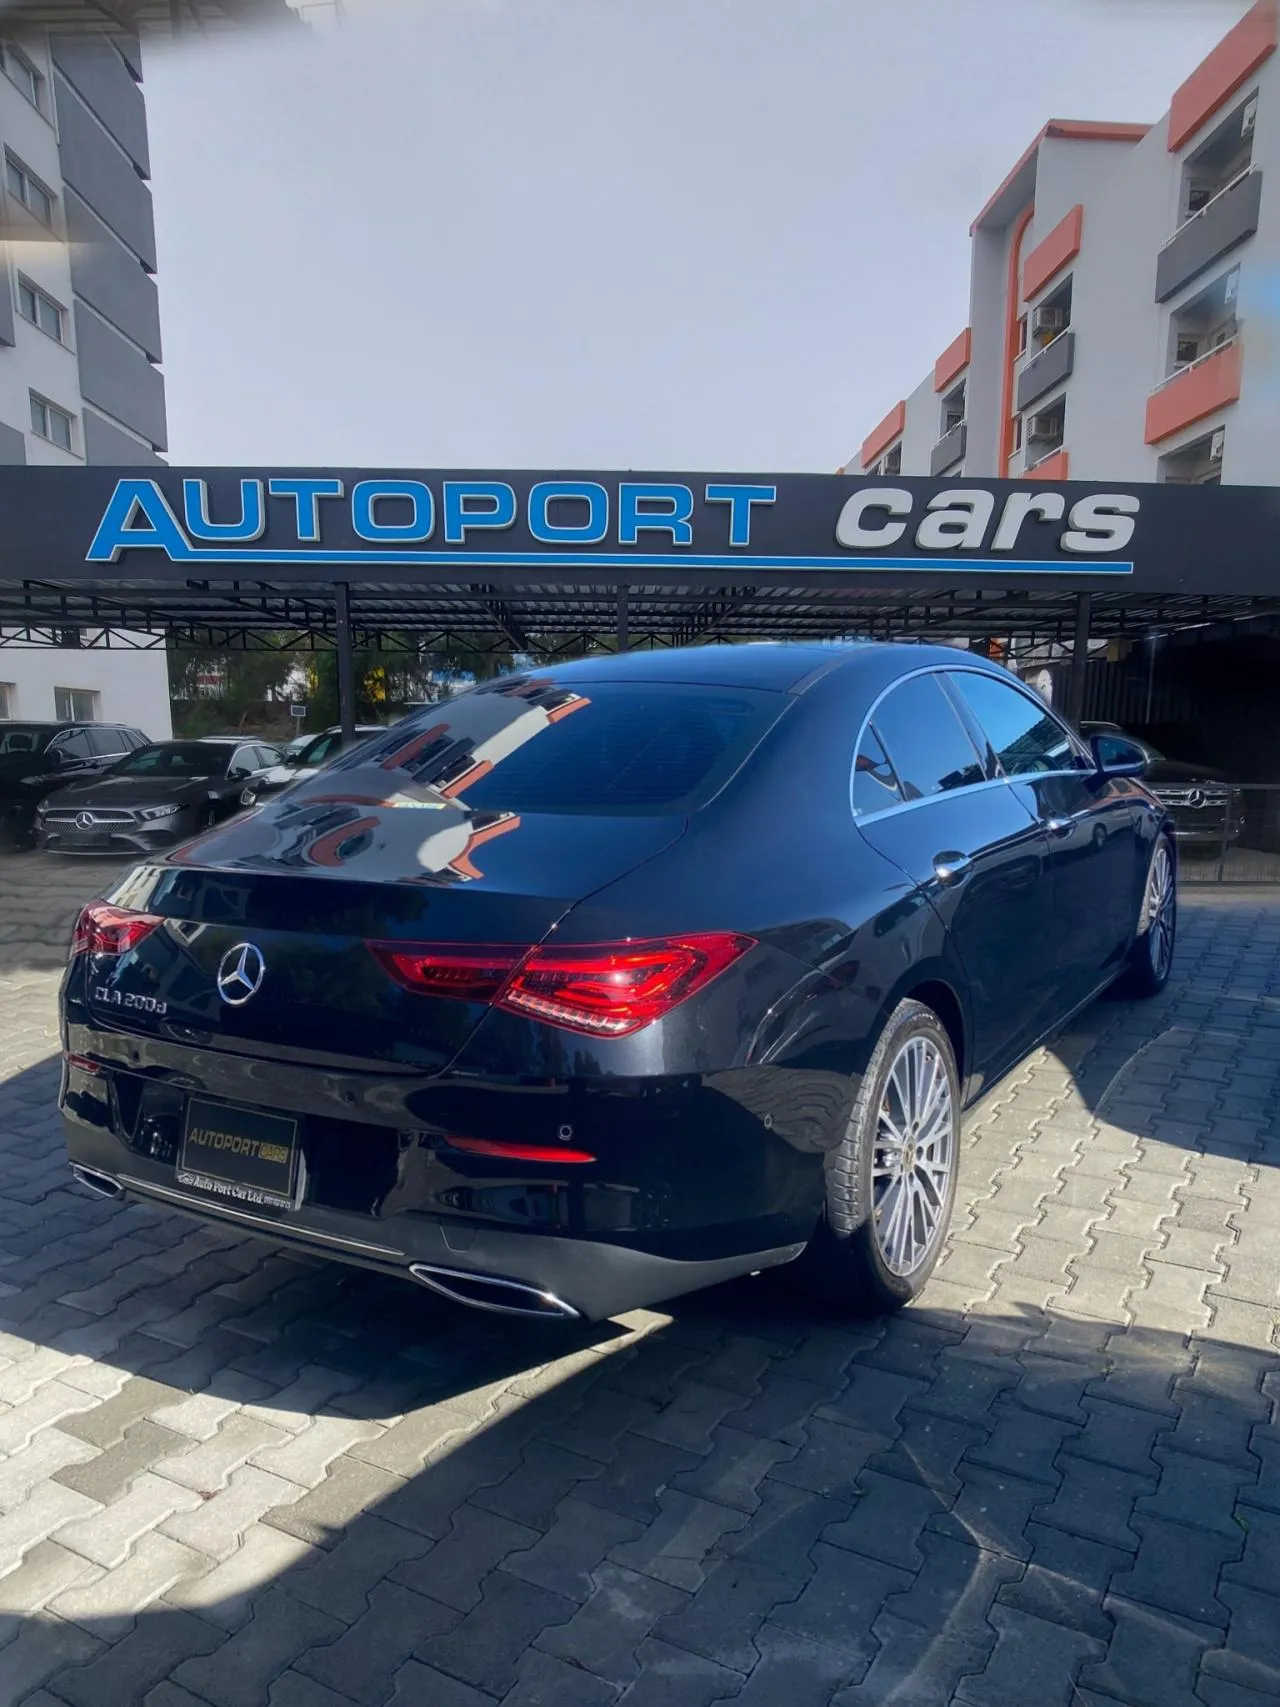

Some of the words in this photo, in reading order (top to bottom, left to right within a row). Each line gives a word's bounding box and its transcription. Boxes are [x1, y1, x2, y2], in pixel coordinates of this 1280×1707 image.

[85, 478, 777, 561] AUTOPORT
[835, 487, 1141, 553] cars
[95, 986, 121, 1005] CLA
[188, 1127, 260, 1157] AUTOPORT
[193, 1176, 213, 1191] Auto
[213, 1180, 231, 1196] Port
